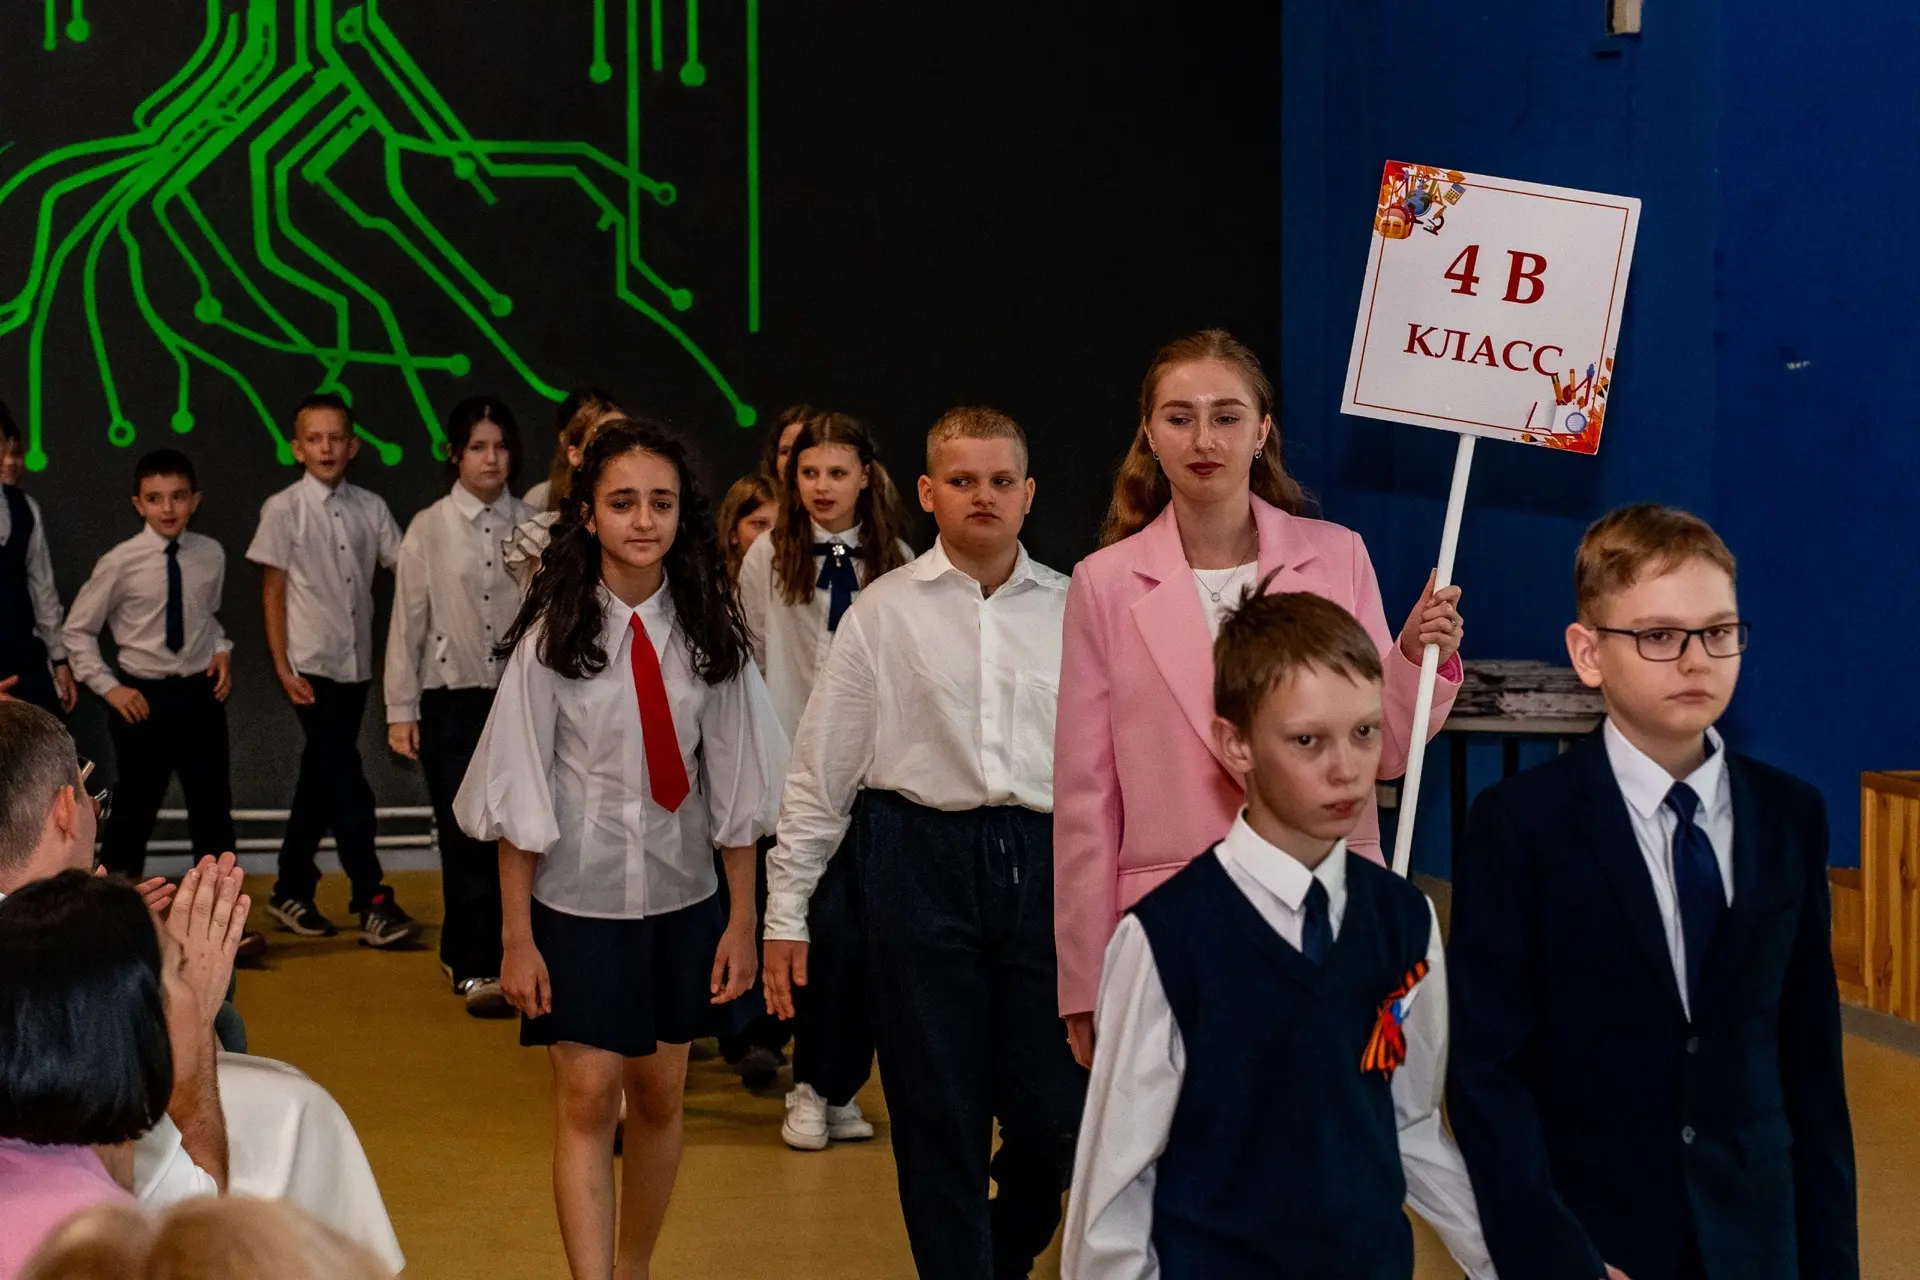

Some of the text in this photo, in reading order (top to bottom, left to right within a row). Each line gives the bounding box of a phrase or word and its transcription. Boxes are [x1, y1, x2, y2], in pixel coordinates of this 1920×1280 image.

[1444, 244, 1548, 304] 4 В
[1403, 322, 1564, 376] КЛАСС
